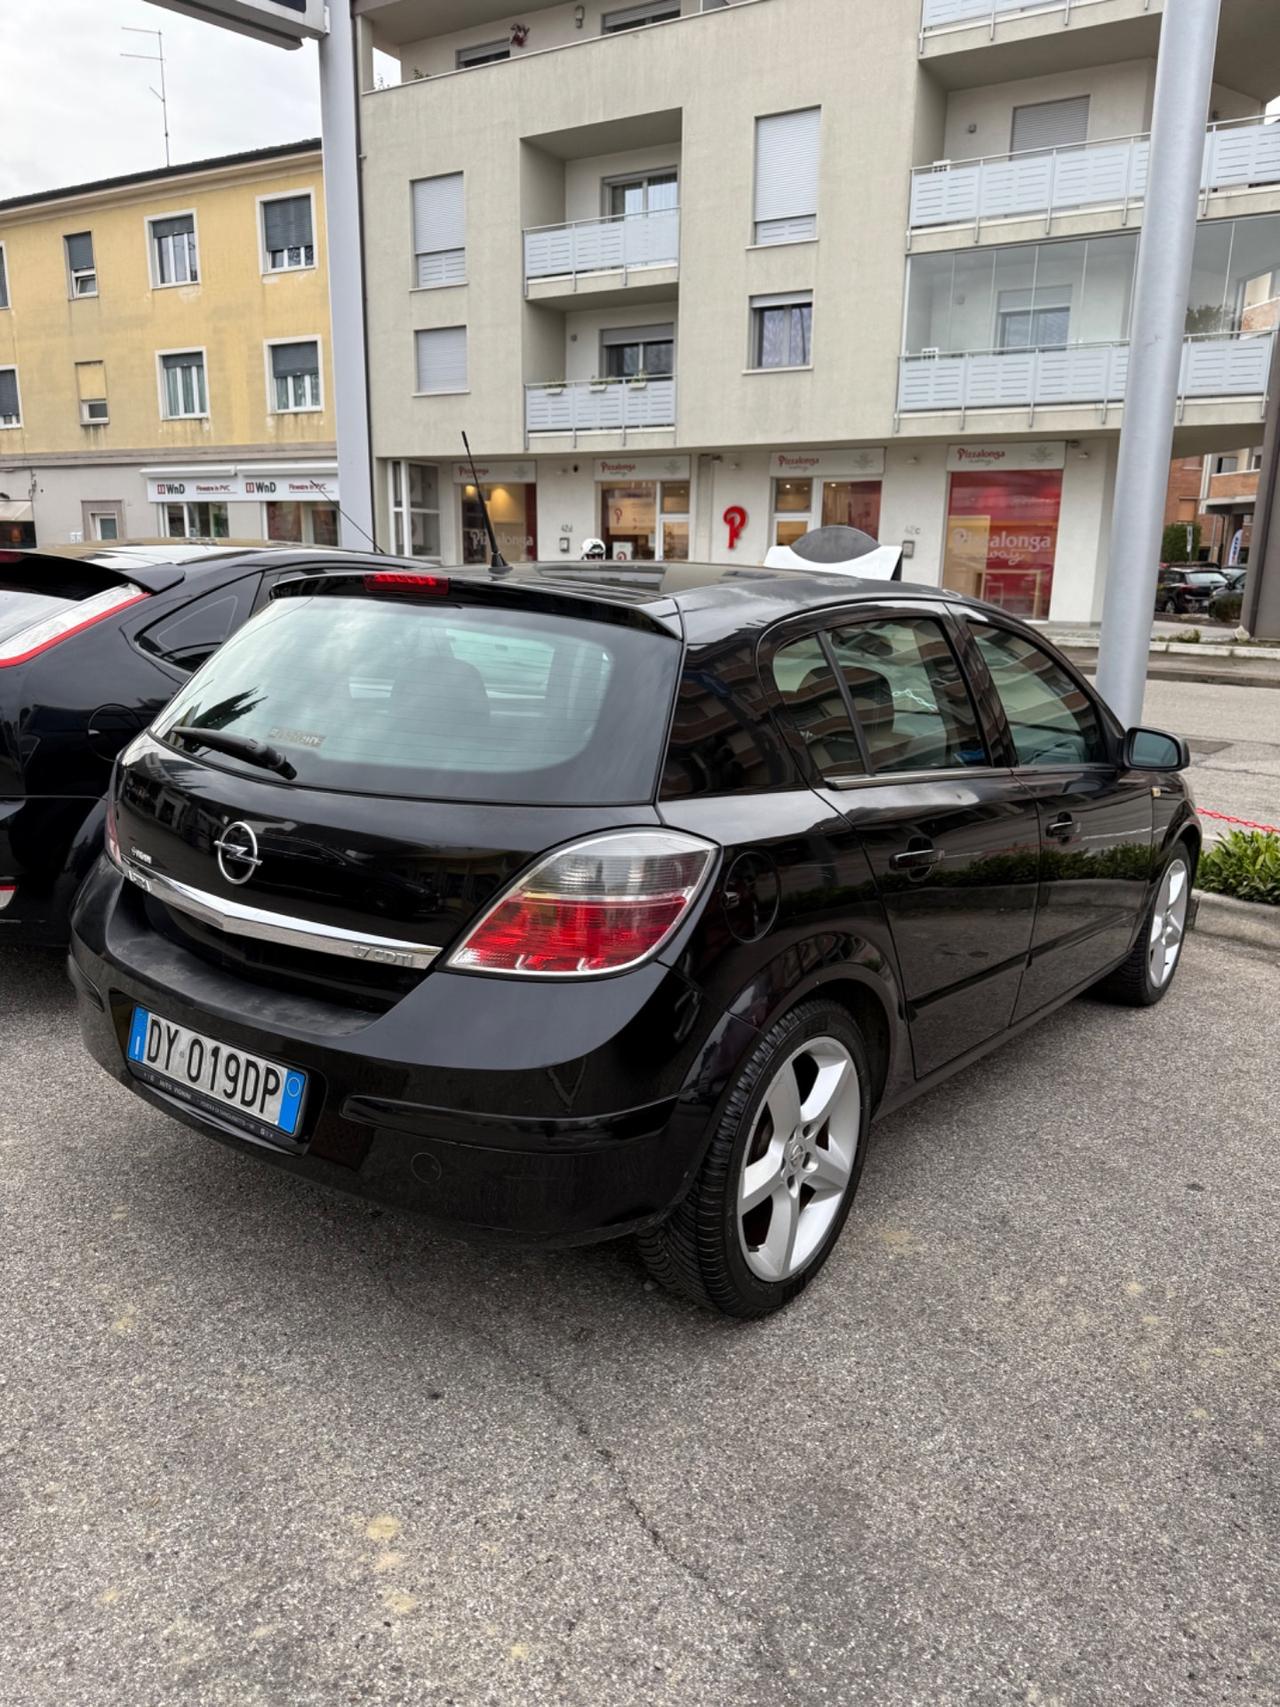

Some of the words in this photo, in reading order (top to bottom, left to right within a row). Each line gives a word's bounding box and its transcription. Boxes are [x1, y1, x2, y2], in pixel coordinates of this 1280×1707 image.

[778, 454, 820, 468] Pizzalonga
[957, 447, 1006, 461] Pizzalonga
[166, 483, 185, 495] WnD
[256, 481, 276, 493] WnD
[147, 1018, 180, 1072] DY
[186, 1037, 281, 1115] 019DP
